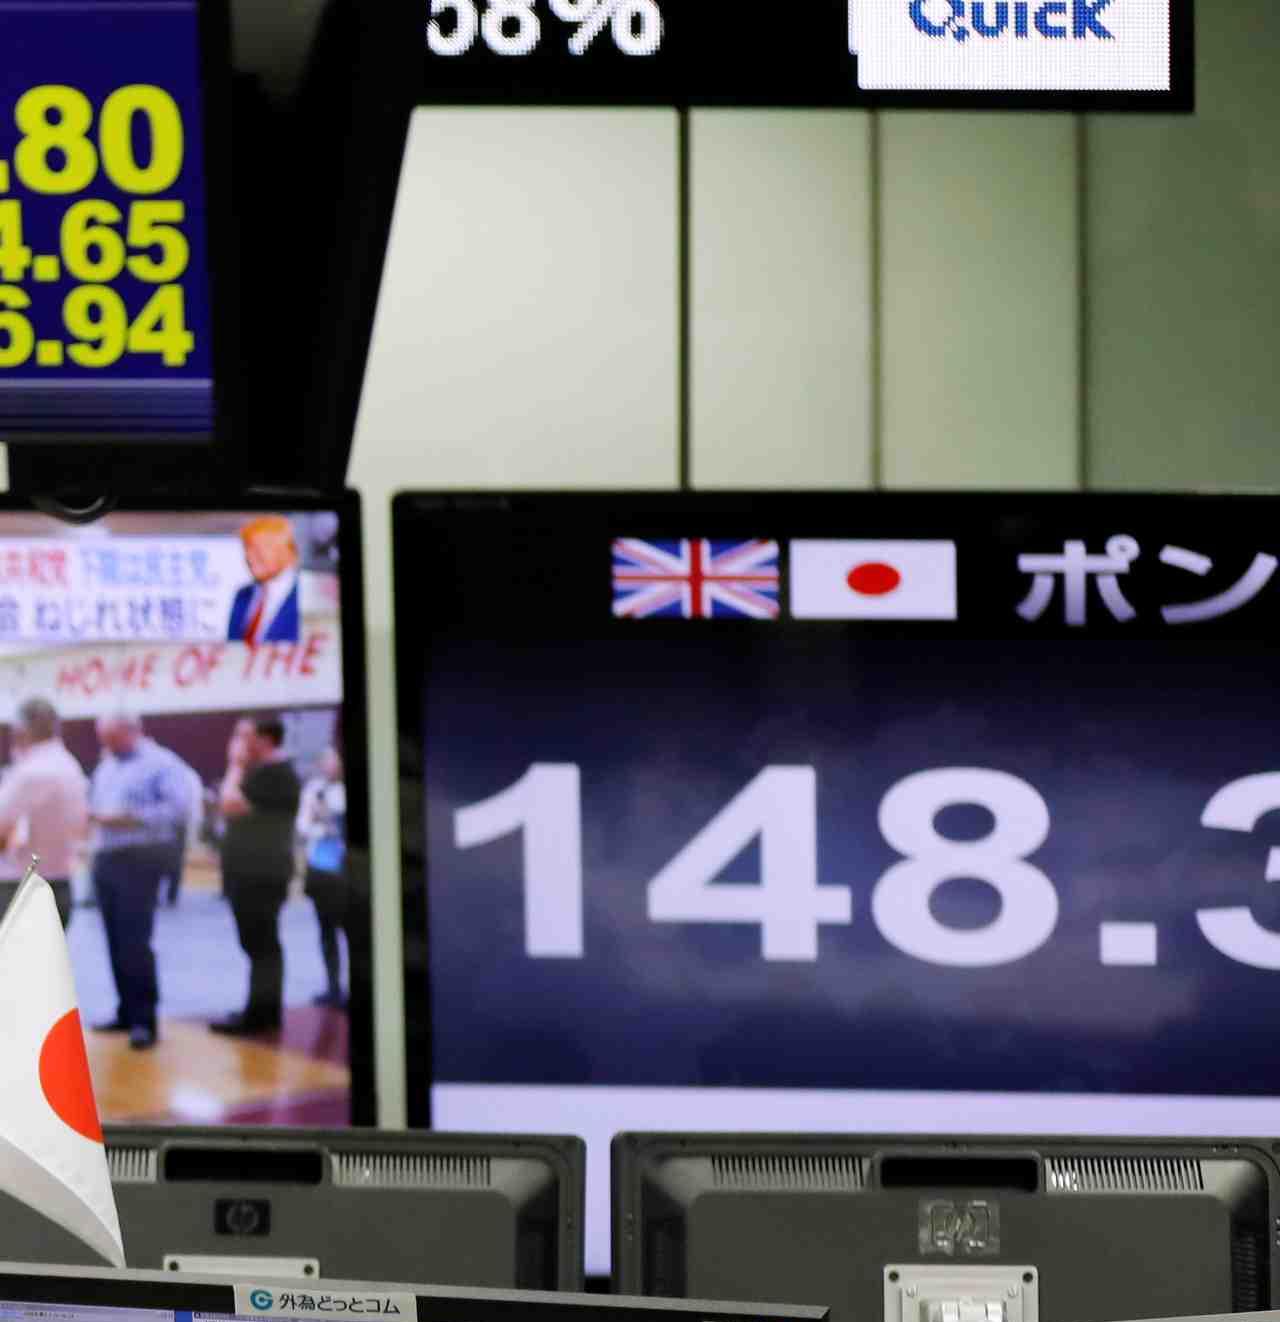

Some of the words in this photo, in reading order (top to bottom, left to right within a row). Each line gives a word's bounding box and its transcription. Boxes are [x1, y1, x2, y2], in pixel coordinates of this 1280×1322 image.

[173, 643, 227, 687] OF
[278, 1292, 401, 1316] 外為どっとコム
